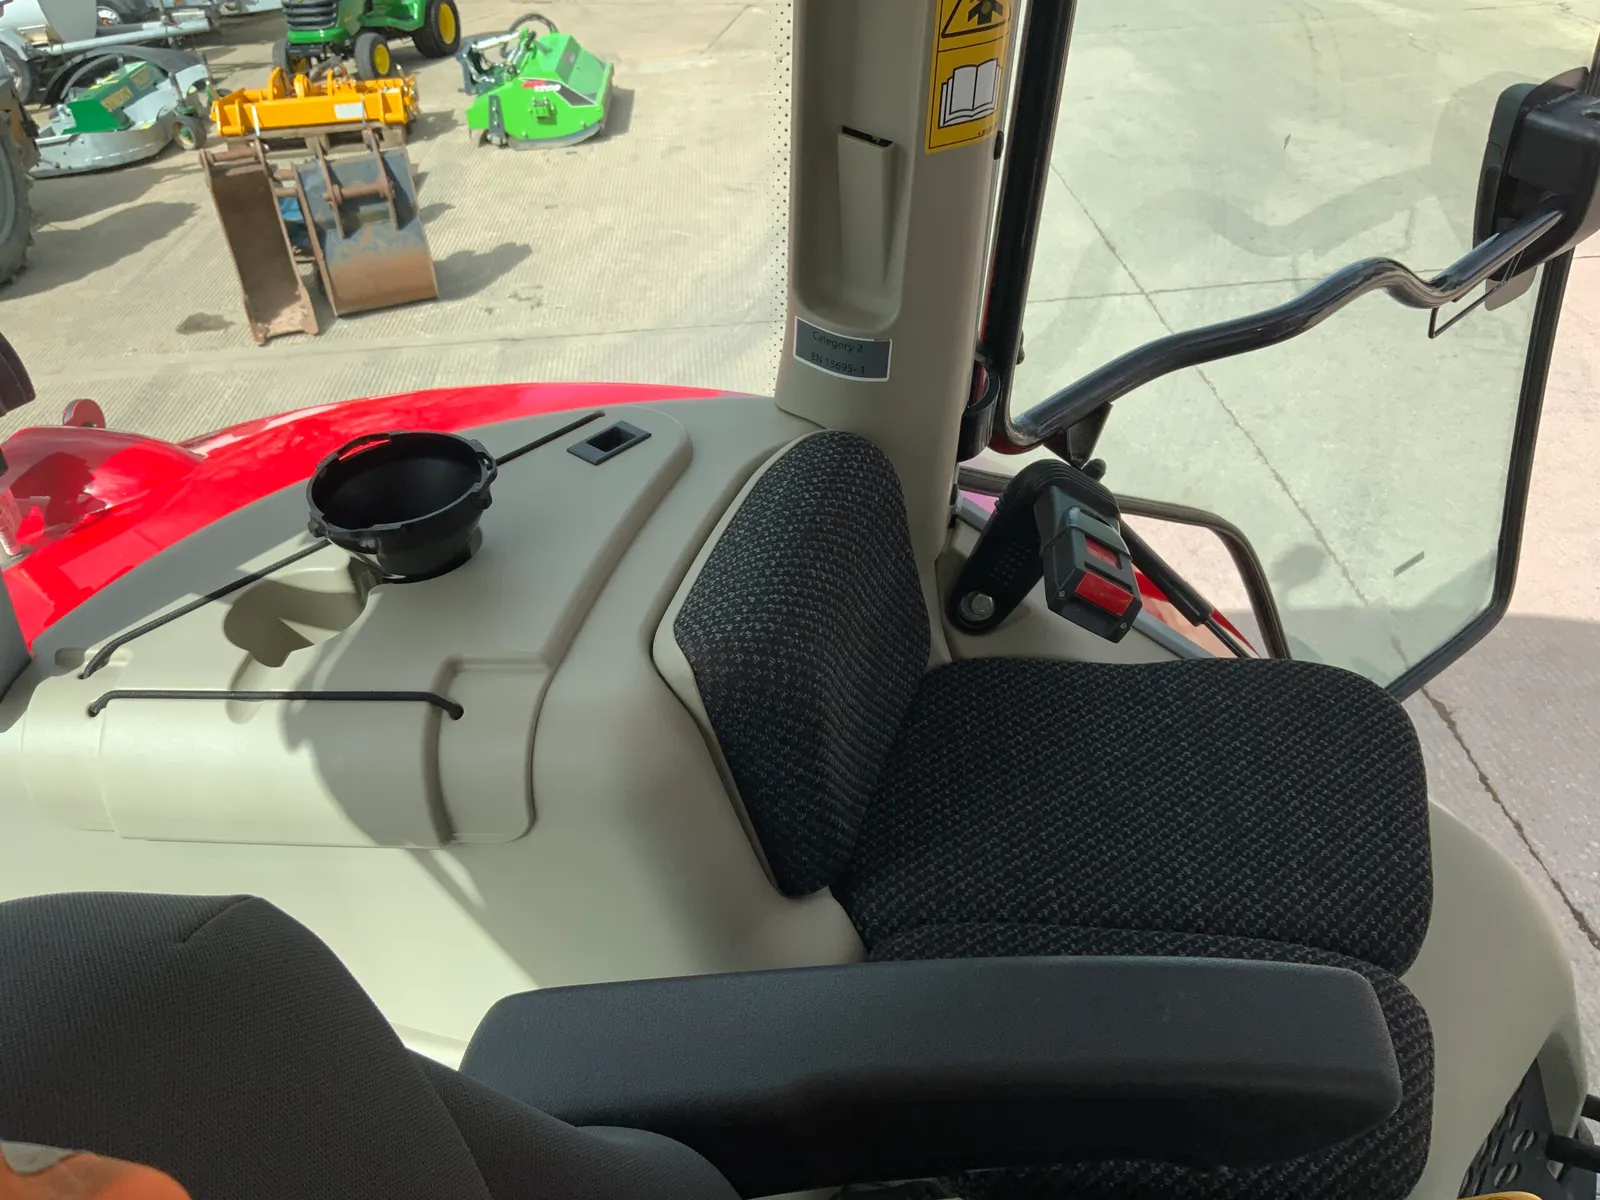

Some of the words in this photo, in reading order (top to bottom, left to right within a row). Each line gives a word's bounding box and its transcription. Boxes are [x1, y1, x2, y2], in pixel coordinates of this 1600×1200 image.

[812, 331, 854, 353] Category
[857, 343, 864, 353] 2
[811, 351, 823, 363] EN
